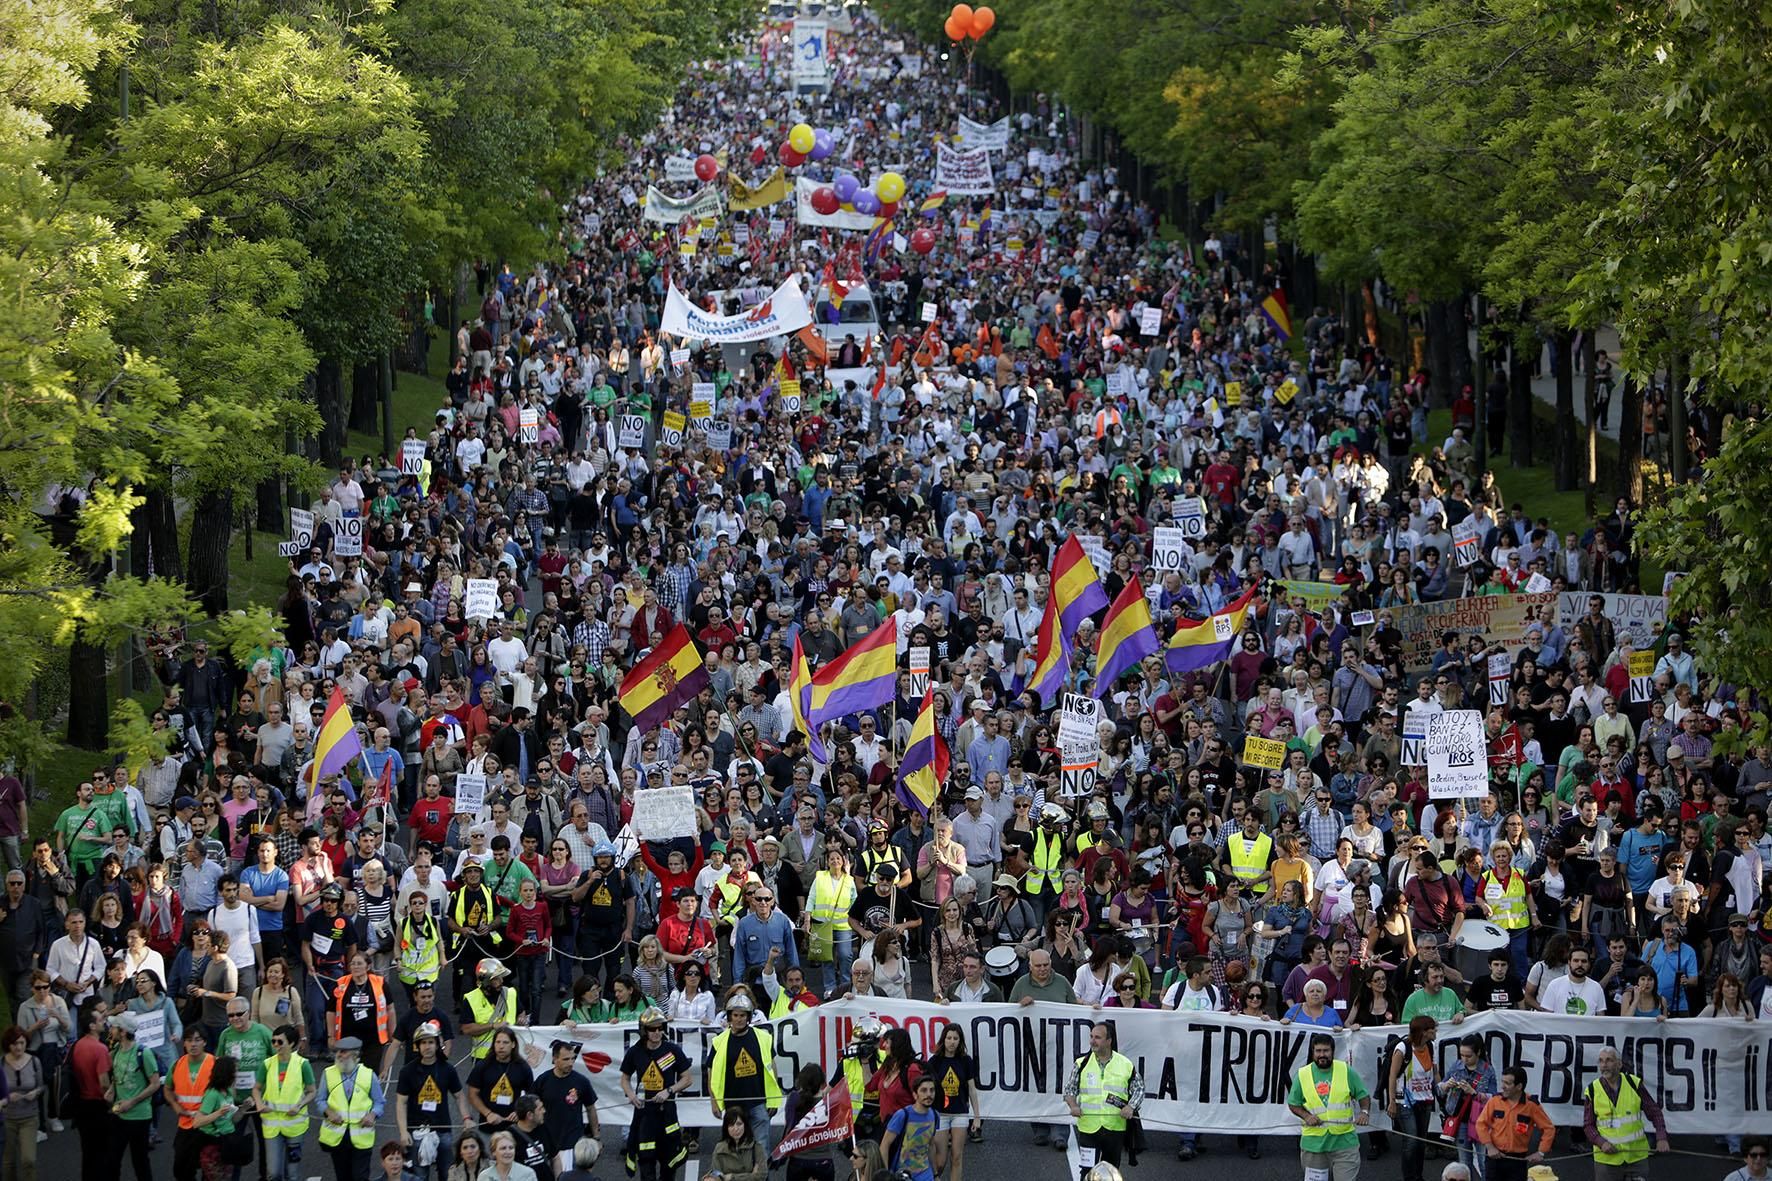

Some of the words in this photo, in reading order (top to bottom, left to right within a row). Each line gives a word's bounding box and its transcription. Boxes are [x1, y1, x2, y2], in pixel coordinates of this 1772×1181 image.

[688, 314, 777, 336] humanista
[783, 396, 799, 410] NO
[622, 416, 643, 431] NO
[522, 427, 536, 441] NO
[663, 429, 680, 446] NO
[404, 458, 422, 473] NO
[336, 519, 361, 537] NO
[1175, 518, 1201, 536] NO
[293, 528, 311, 548] NO
[280, 543, 298, 556] NO
[1457, 543, 1477, 565] NO
[1154, 549, 1179, 569] NO
[1616, 598, 1665, 620] DIGNA
[1216, 624, 1230, 634] RPS
[1427, 610, 1491, 630] RECUPERANDO
[1632, 677, 1653, 701] NO
[1249, 739, 1257, 749] TU
[1258, 741, 1283, 754] SOBRE
[1246, 752, 1252, 762] MI
[1253, 753, 1281, 767] RECORTE
[1448, 751, 1475, 765] IROS
[1062, 768, 1095, 795] NO
[1138, 1056, 1178, 1101] LA
